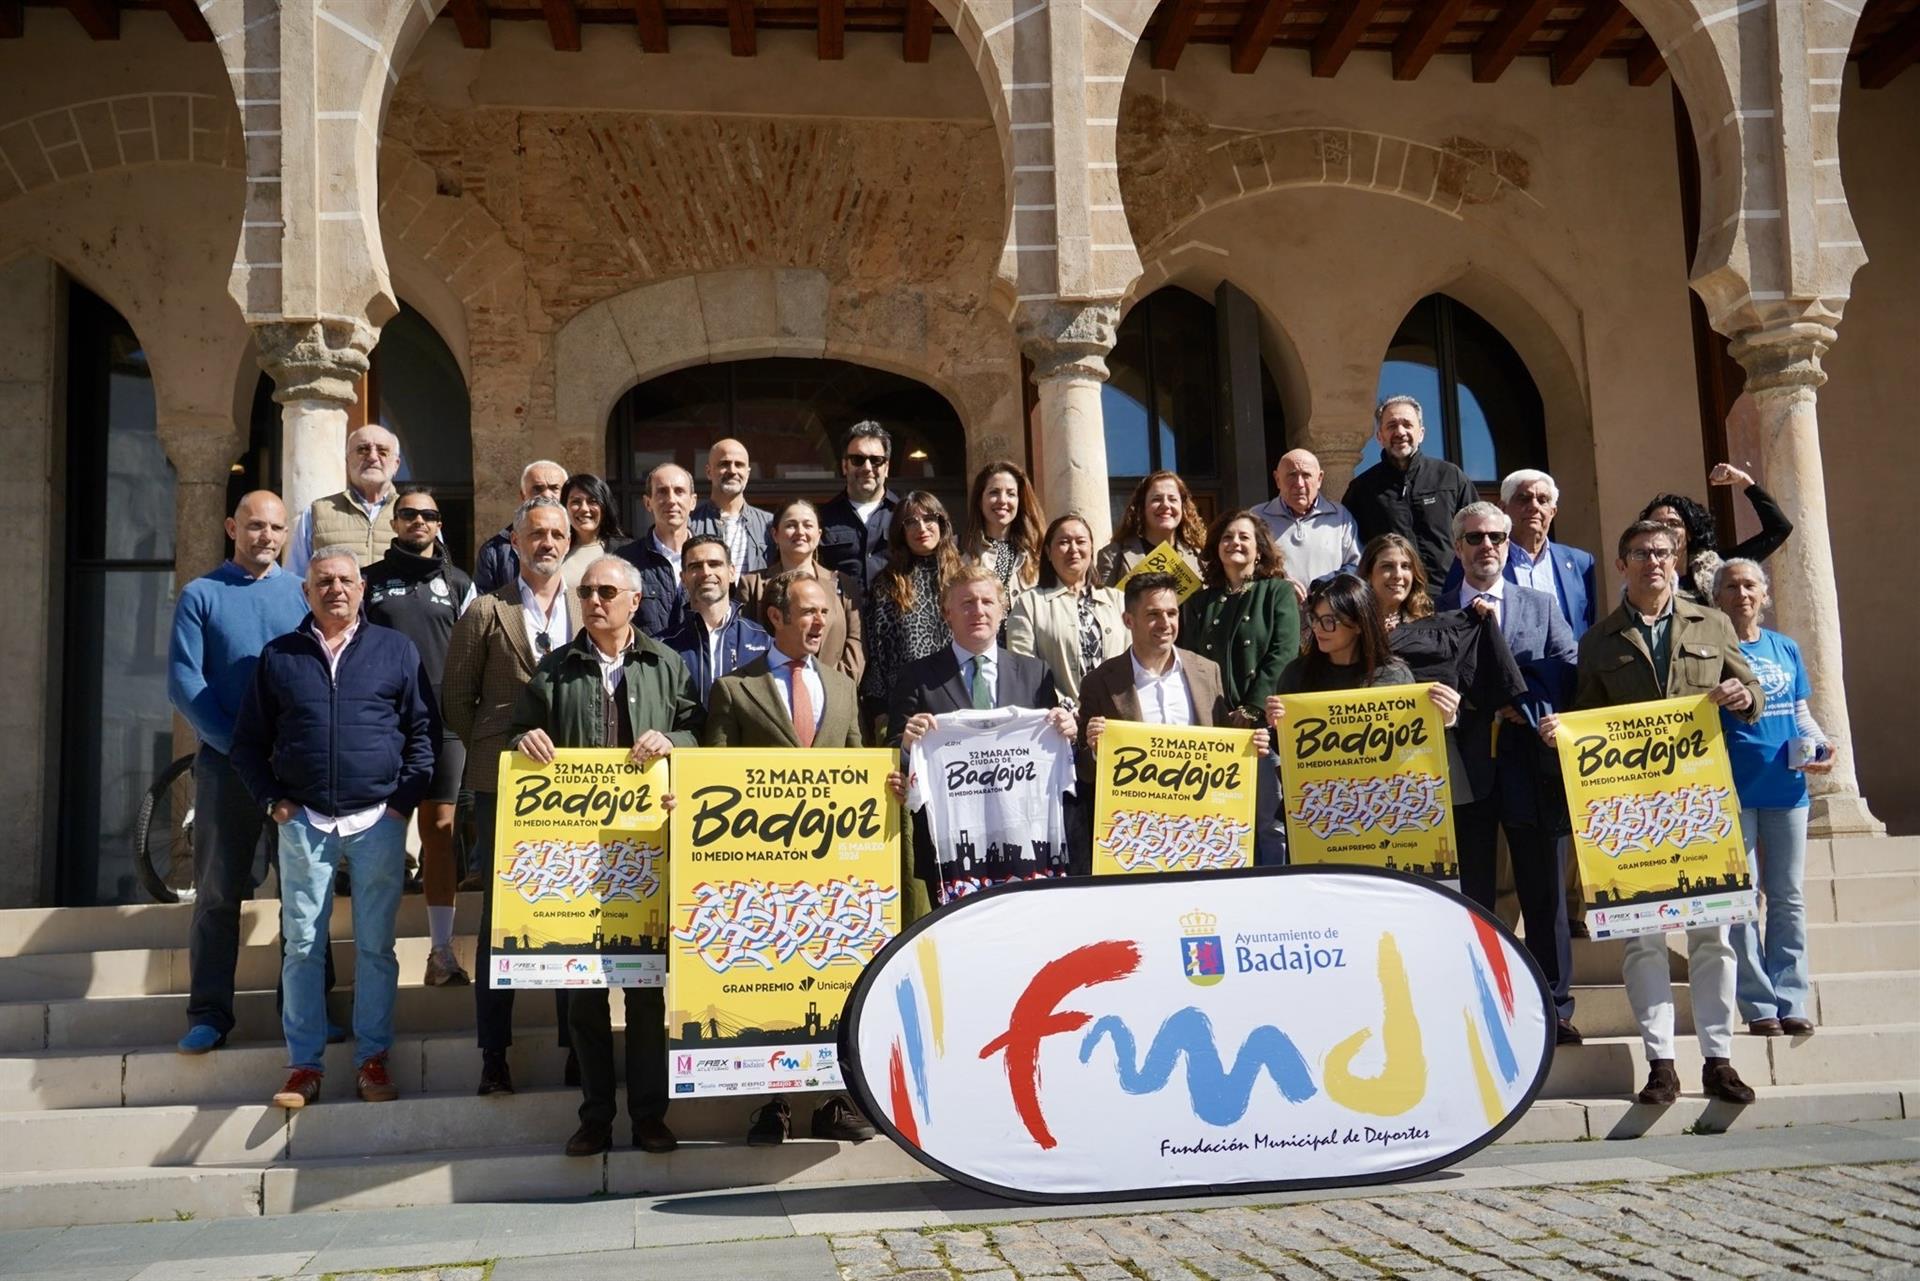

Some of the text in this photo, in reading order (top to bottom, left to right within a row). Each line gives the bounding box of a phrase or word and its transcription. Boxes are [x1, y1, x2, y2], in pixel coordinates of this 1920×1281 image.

[1328, 697, 1416, 716] 32 MARATÓN
[1329, 712, 1389, 725] CIUDAD DE
[1606, 710, 1694, 732] 32 MARATÓN
[1293, 717, 1428, 761] Badajoz
[1609, 726, 1669, 741] CIUDAD DE
[1150, 737, 1235, 753] 32 MARATÓN
[969, 747, 1029, 759] 32 MARATÓN
[1150, 749, 1208, 761] CIUDAD DE
[1573, 729, 1709, 777] Badajoz
[554, 761, 644, 774] 32 MARATÓN
[970, 758, 1000, 766] CIUDAD
[1297, 756, 1377, 769] 10 MEDIO MARATÓN
[554, 775, 616, 784] CIUDAD DE
[746, 765, 868, 784] 32 MARATÓN
[945, 761, 1036, 791] Badajoz
[1113, 747, 1241, 800] Badajoz
[1581, 770, 1661, 788] 10 MEDIO MARATÓN
[746, 787, 830, 798] CIUDAD DE
[1112, 789, 1190, 801] 10 MEDIO MARATÓN
[515, 775, 652, 826] Badajoz
[514, 819, 598, 827] 10 MEDIO MARATÓN
[691, 785, 881, 859] Badajoz
[1349, 843, 1376, 851] PREMIO
[1392, 840, 1418, 849] Unicaja
[692, 849, 808, 862] 10 MEDIO MARATÓN
[1618, 853, 1708, 871] GRAN PREMIO Unicaja
[602, 911, 628, 919] Unicaja
[1235, 928, 1339, 944] Ayuntamiento de
[1235, 944, 1347, 974] Badajoz
[723, 981, 852, 993] GRAN PREMIO Unicaja
[1161, 1126, 1429, 1157] Fundación Municipal de Deportes
